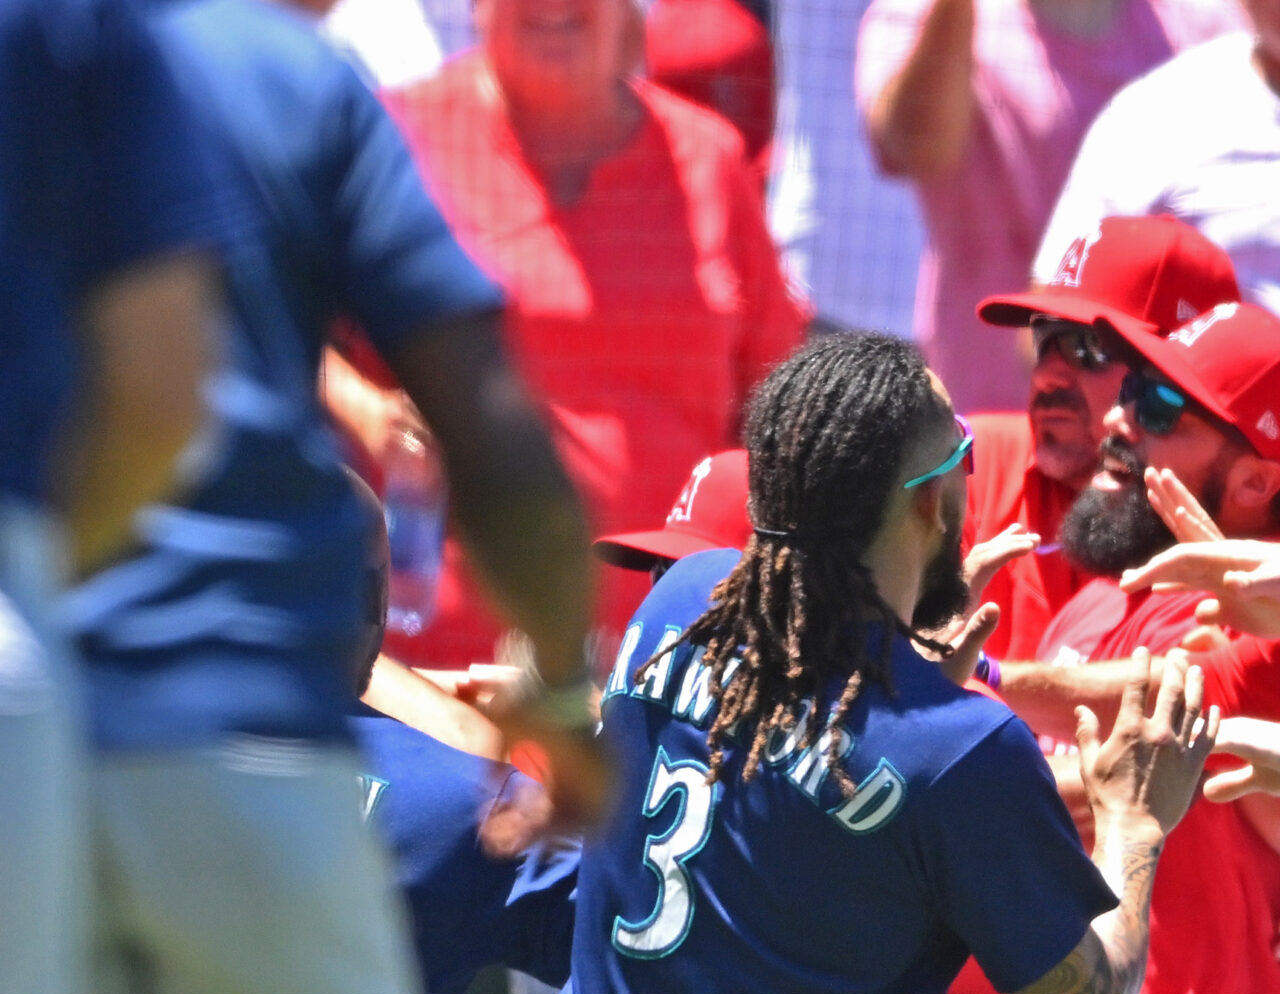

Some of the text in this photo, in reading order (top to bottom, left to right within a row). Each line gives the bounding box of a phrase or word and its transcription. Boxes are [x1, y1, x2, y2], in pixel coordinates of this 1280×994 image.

[1051, 230, 1102, 287] A
[666, 456, 712, 523] A
[601, 621, 908, 835] RAWORD
[611, 745, 717, 959] 3
